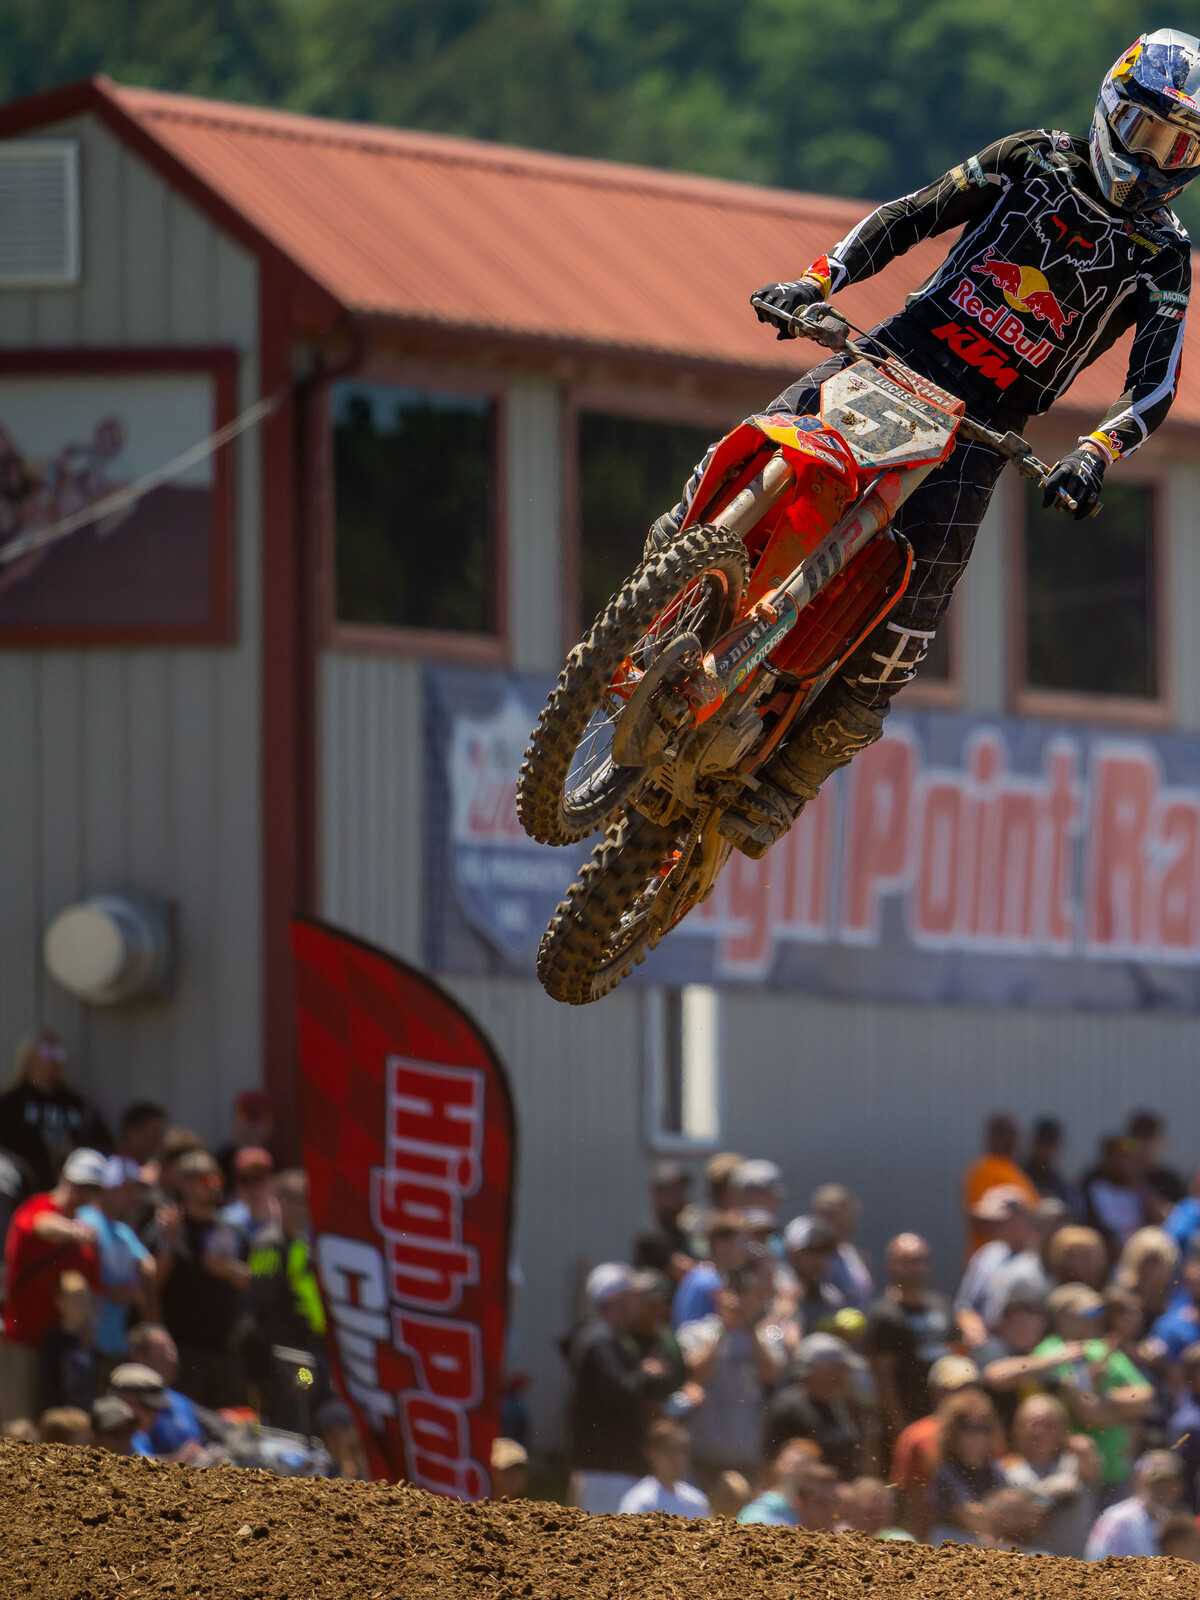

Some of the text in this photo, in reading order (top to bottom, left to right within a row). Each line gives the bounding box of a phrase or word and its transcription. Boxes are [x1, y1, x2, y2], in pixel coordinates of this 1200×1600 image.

[949, 277, 1055, 368] Red Bull
[931, 322, 1020, 391] KTM
[823, 389, 934, 455] 5
[875, 378, 912, 401] LUCAS
[909, 398, 929, 413] OIL
[727, 598, 786, 662] DUNLP
[745, 621, 790, 674] MOTOREX
[843, 731, 1076, 950] Point
[371, 1058, 485, 1312] High
